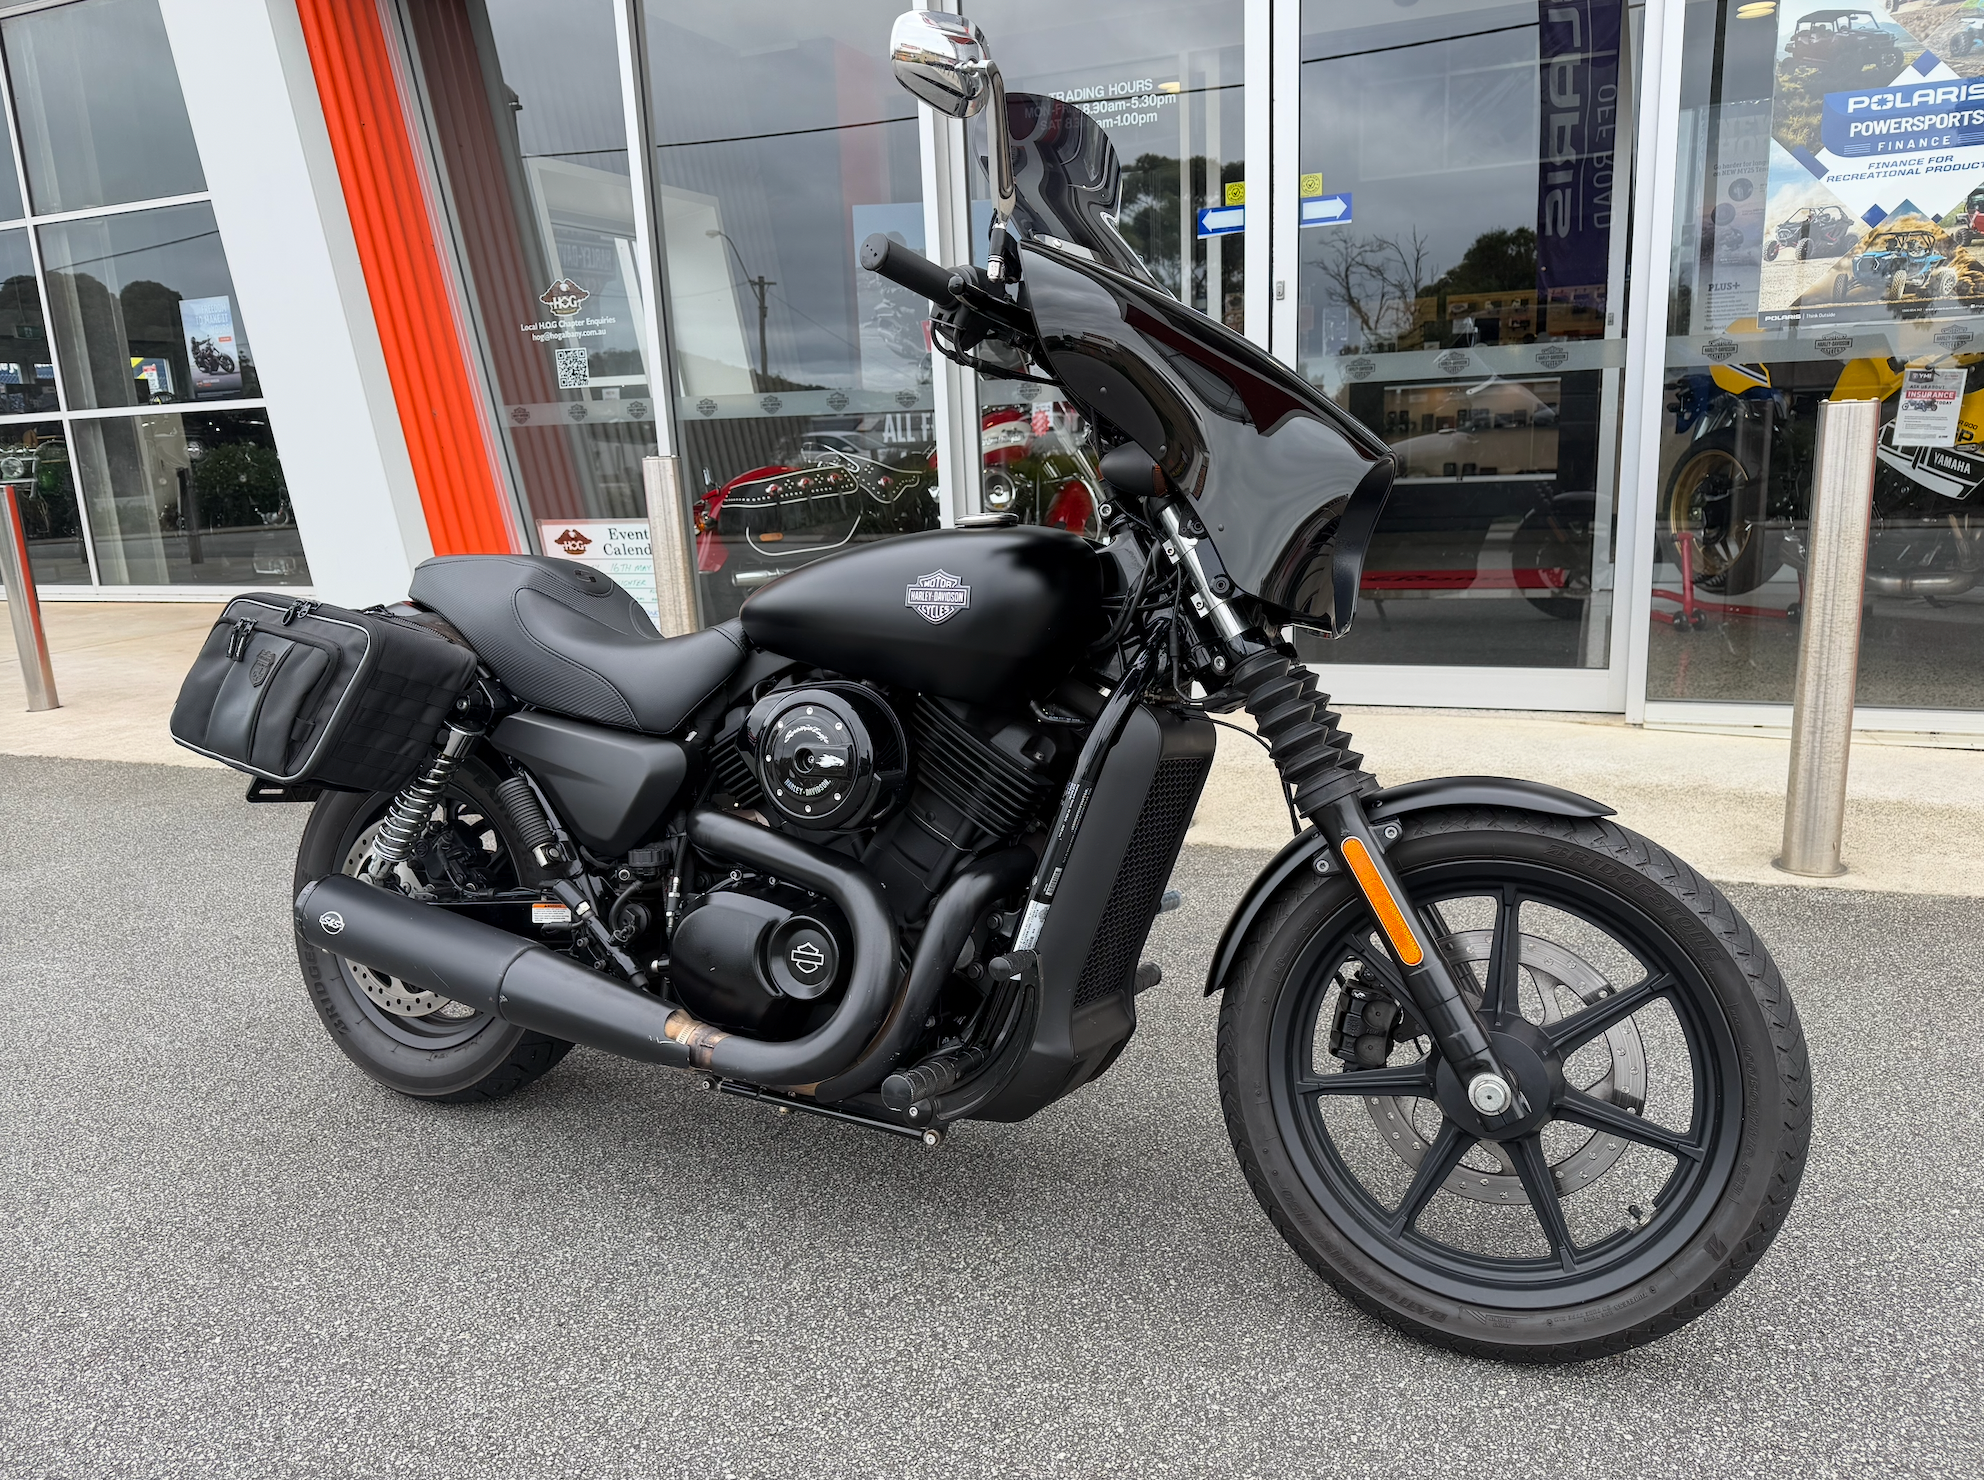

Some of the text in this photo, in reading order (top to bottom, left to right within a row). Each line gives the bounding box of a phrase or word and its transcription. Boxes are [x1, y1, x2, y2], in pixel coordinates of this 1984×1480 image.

[1048, 78, 1153, 102] TRADING HOURS
[1847, 84, 1984, 113] POLARIS
[1040, 118, 1062, 130] SAT
[1850, 109, 1984, 138] POWERSPORTS
[1878, 135, 1951, 151] FINANCE
[1868, 155, 1954, 170] FINANCE FOR
[1826, 167, 1922, 183] RECREATIONAL
[552, 294, 577, 310] HOG
[520, 322, 538, 331] Local
[558, 319, 585, 329] Chapter
[586, 315, 617, 326] Enquiries
[1765, 314, 1802, 322] POLARIS
[1907, 391, 1955, 399] INSURANCE
[882, 413, 916, 443] ALL
[1934, 452, 1971, 474] YAMAHA
[608, 528, 649, 540] Event
[563, 540, 585, 551] HOG
[923, 576, 952, 588] MOTOR
[910, 590, 964, 603] HARLEY-DAVIDSON
[921, 604, 950, 618] CYCLES
[1544, 843, 1724, 962] BRIDGESTONE
